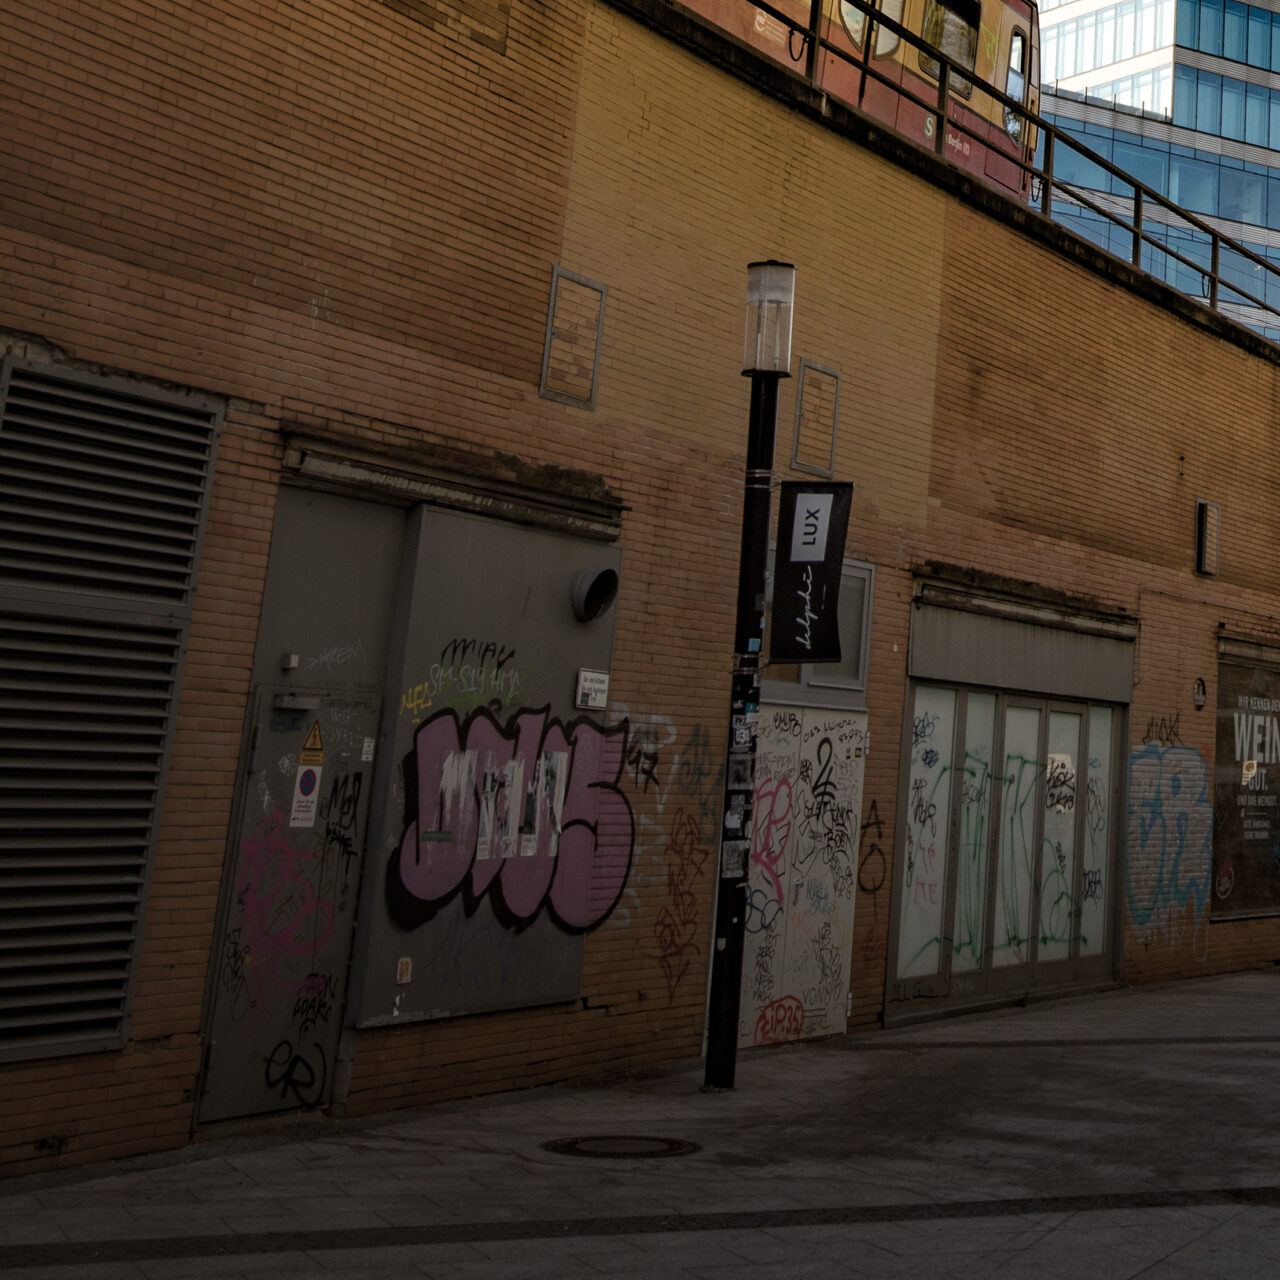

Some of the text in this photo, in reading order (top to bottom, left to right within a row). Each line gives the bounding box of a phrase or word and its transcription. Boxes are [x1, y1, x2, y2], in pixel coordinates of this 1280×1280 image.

[925, 117, 935, 138] S
[795, 508, 821, 650] delphi LUX
[1238, 695, 1249, 708] WIR
[1250, 697, 1271, 711] KENNEN
